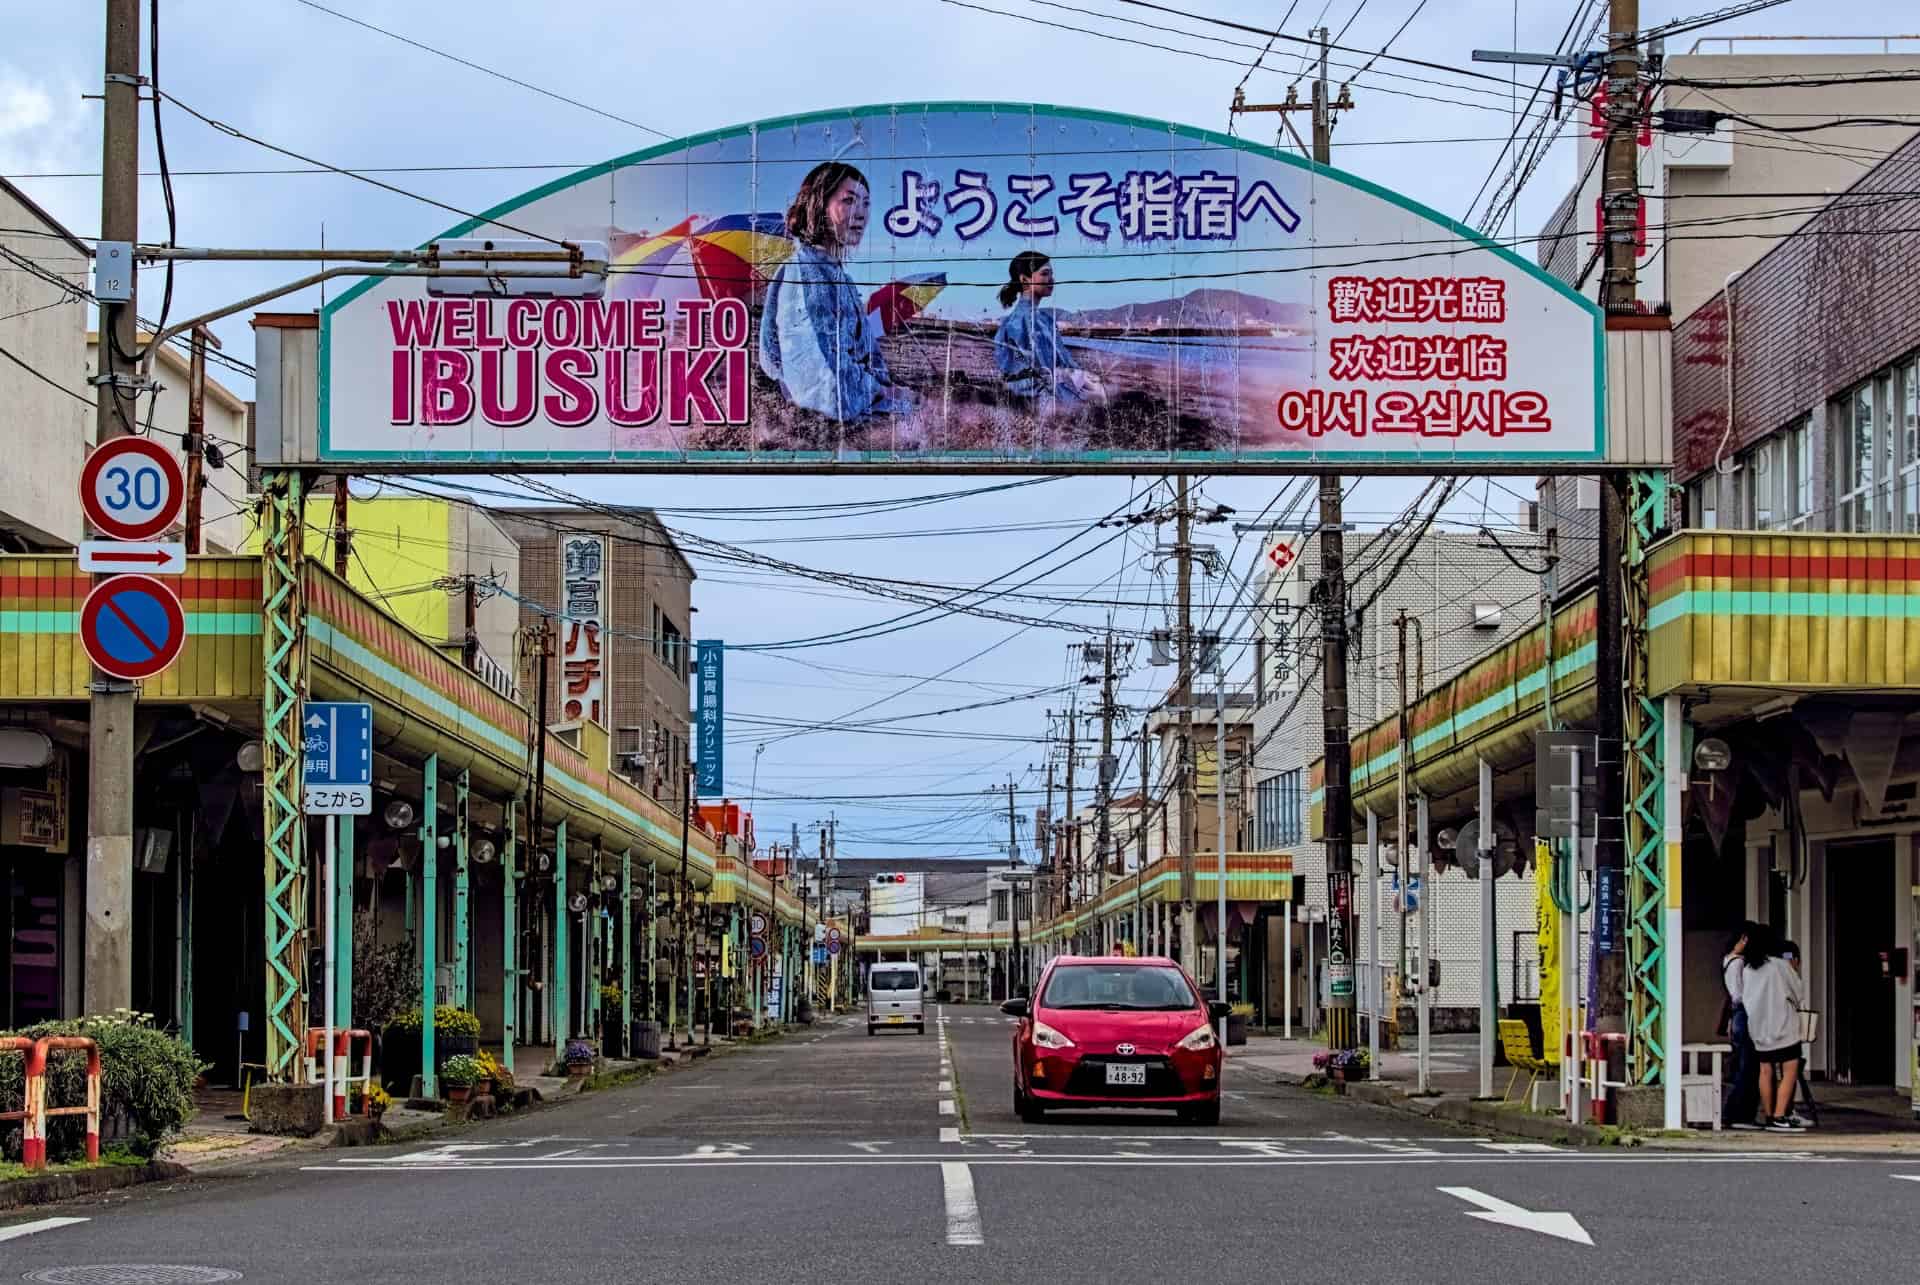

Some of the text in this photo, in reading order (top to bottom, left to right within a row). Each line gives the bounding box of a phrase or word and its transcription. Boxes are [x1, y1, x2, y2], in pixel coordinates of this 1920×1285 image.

[884, 169, 1301, 241] ようこそ指宿へ
[106, 279, 120, 291] 12
[1328, 276, 1506, 323] 歡迎光臨
[387, 298, 751, 350] WELCOME TO
[1329, 334, 1507, 381] 欢迎光临
[390, 348, 751, 428] IBUSUKI
[1278, 389, 1552, 438] 어서 오십시오
[104, 466, 162, 512] 30
[1273, 598, 1290, 681] 日本生命
[702, 649, 718, 787] 小吉胃腸科クリニック
[304, 759, 329, 773] 専用
